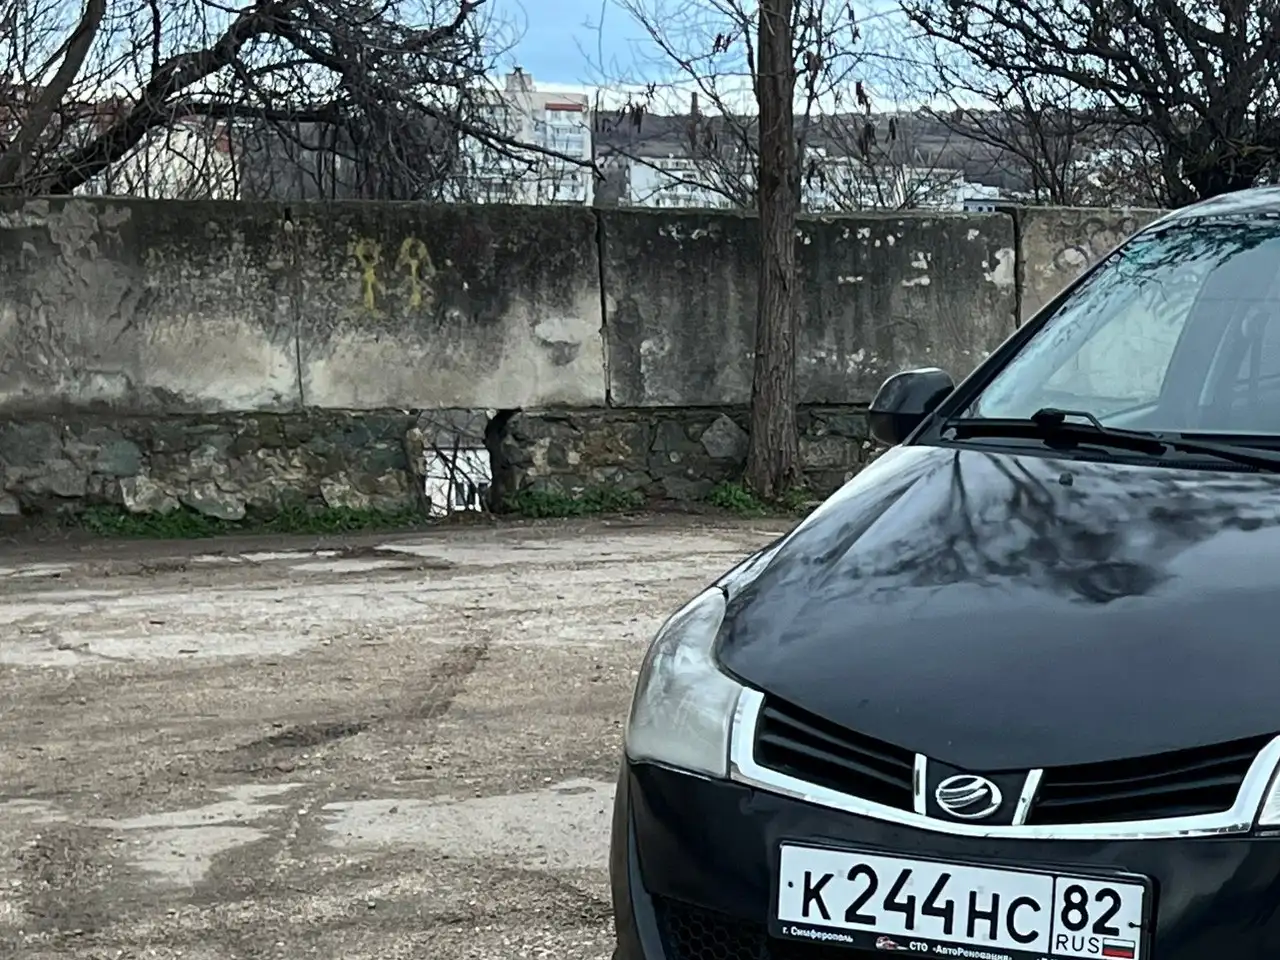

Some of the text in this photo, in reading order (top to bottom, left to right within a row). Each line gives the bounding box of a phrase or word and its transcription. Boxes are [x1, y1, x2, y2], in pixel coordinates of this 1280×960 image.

[802, 863, 1122, 944] К244НС 82
[782, 926, 854, 942] г. Симферополь
[909, 941, 928, 952] СТО
[1056, 934, 1100, 954] RUS
